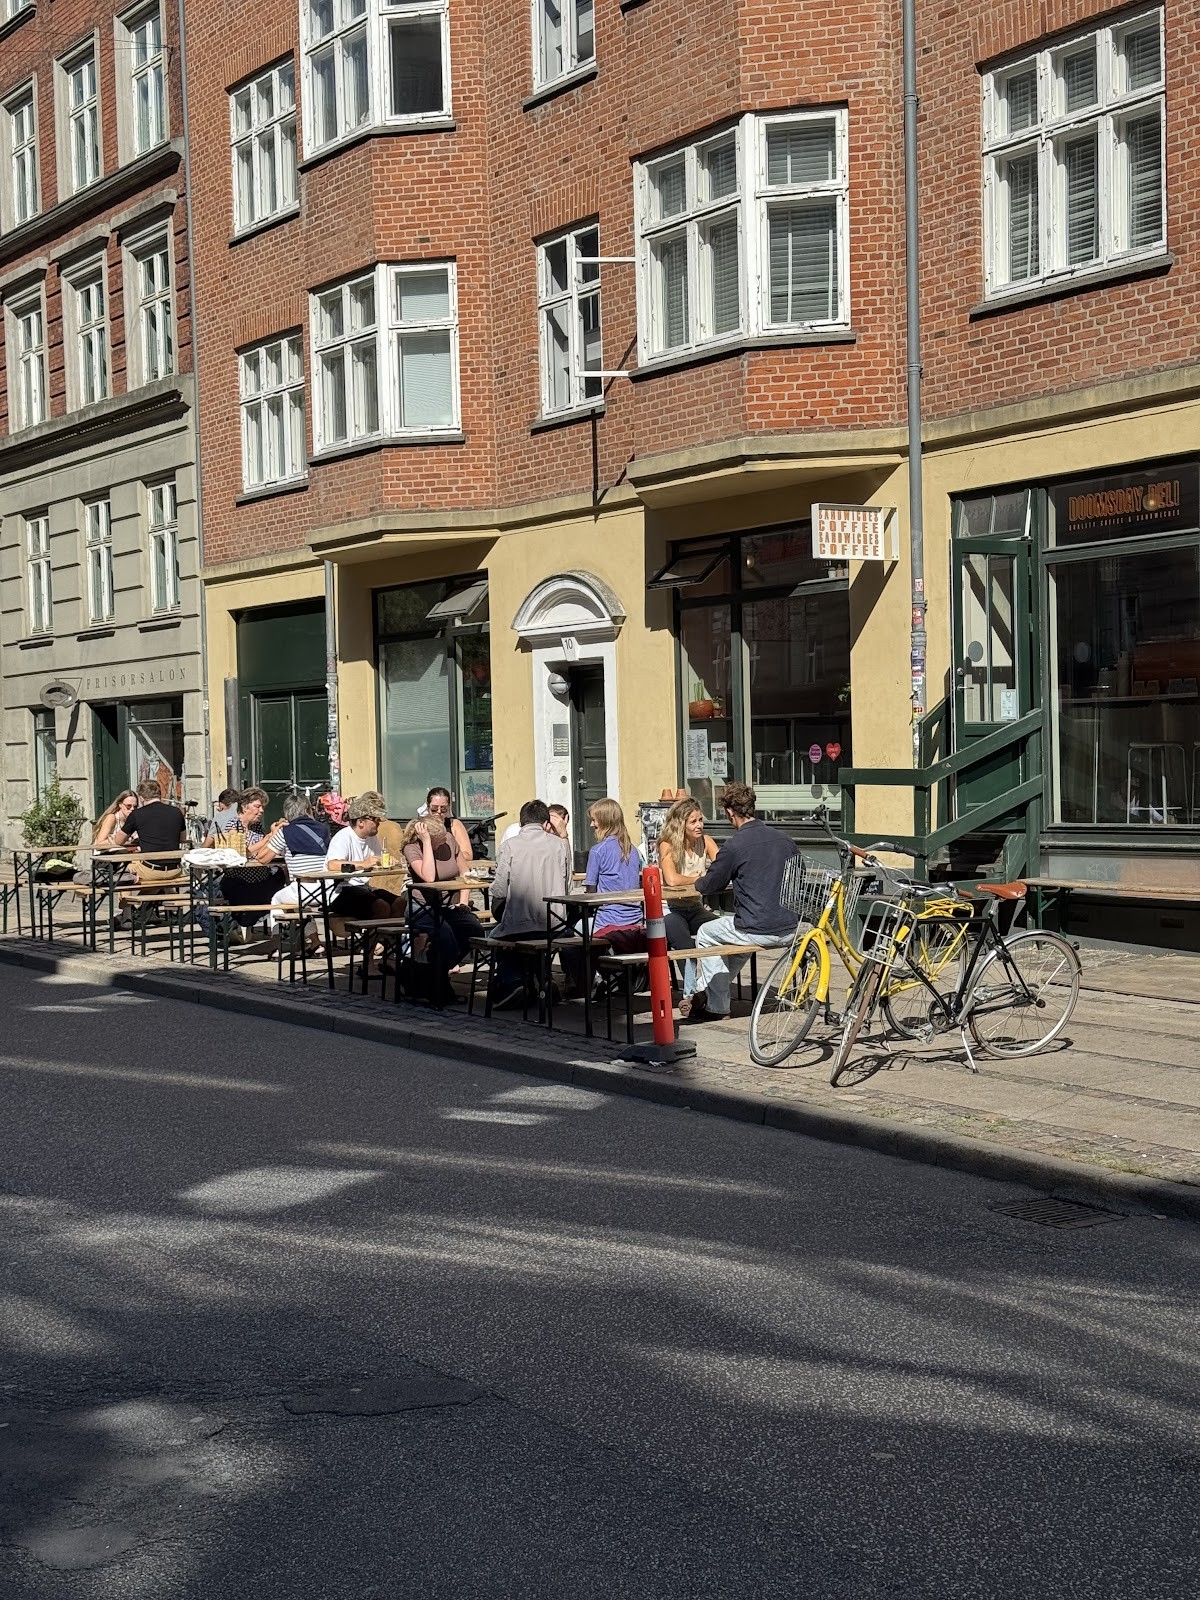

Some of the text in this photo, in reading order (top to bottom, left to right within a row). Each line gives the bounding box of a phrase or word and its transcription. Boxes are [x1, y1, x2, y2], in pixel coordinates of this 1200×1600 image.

[1068, 480, 1180, 521] DOOMSDAY DELI
[819, 510, 879, 522] SANDWICHES
[1100, 517, 1124, 527] COFFEE
[1136, 509, 1180, 521] SANDWICHES
[819, 520, 879, 533] COFFEE
[819, 531, 879, 545] SANDWICHES
[819, 544, 879, 556] COFFEE
[564, 638, 573, 649] 10
